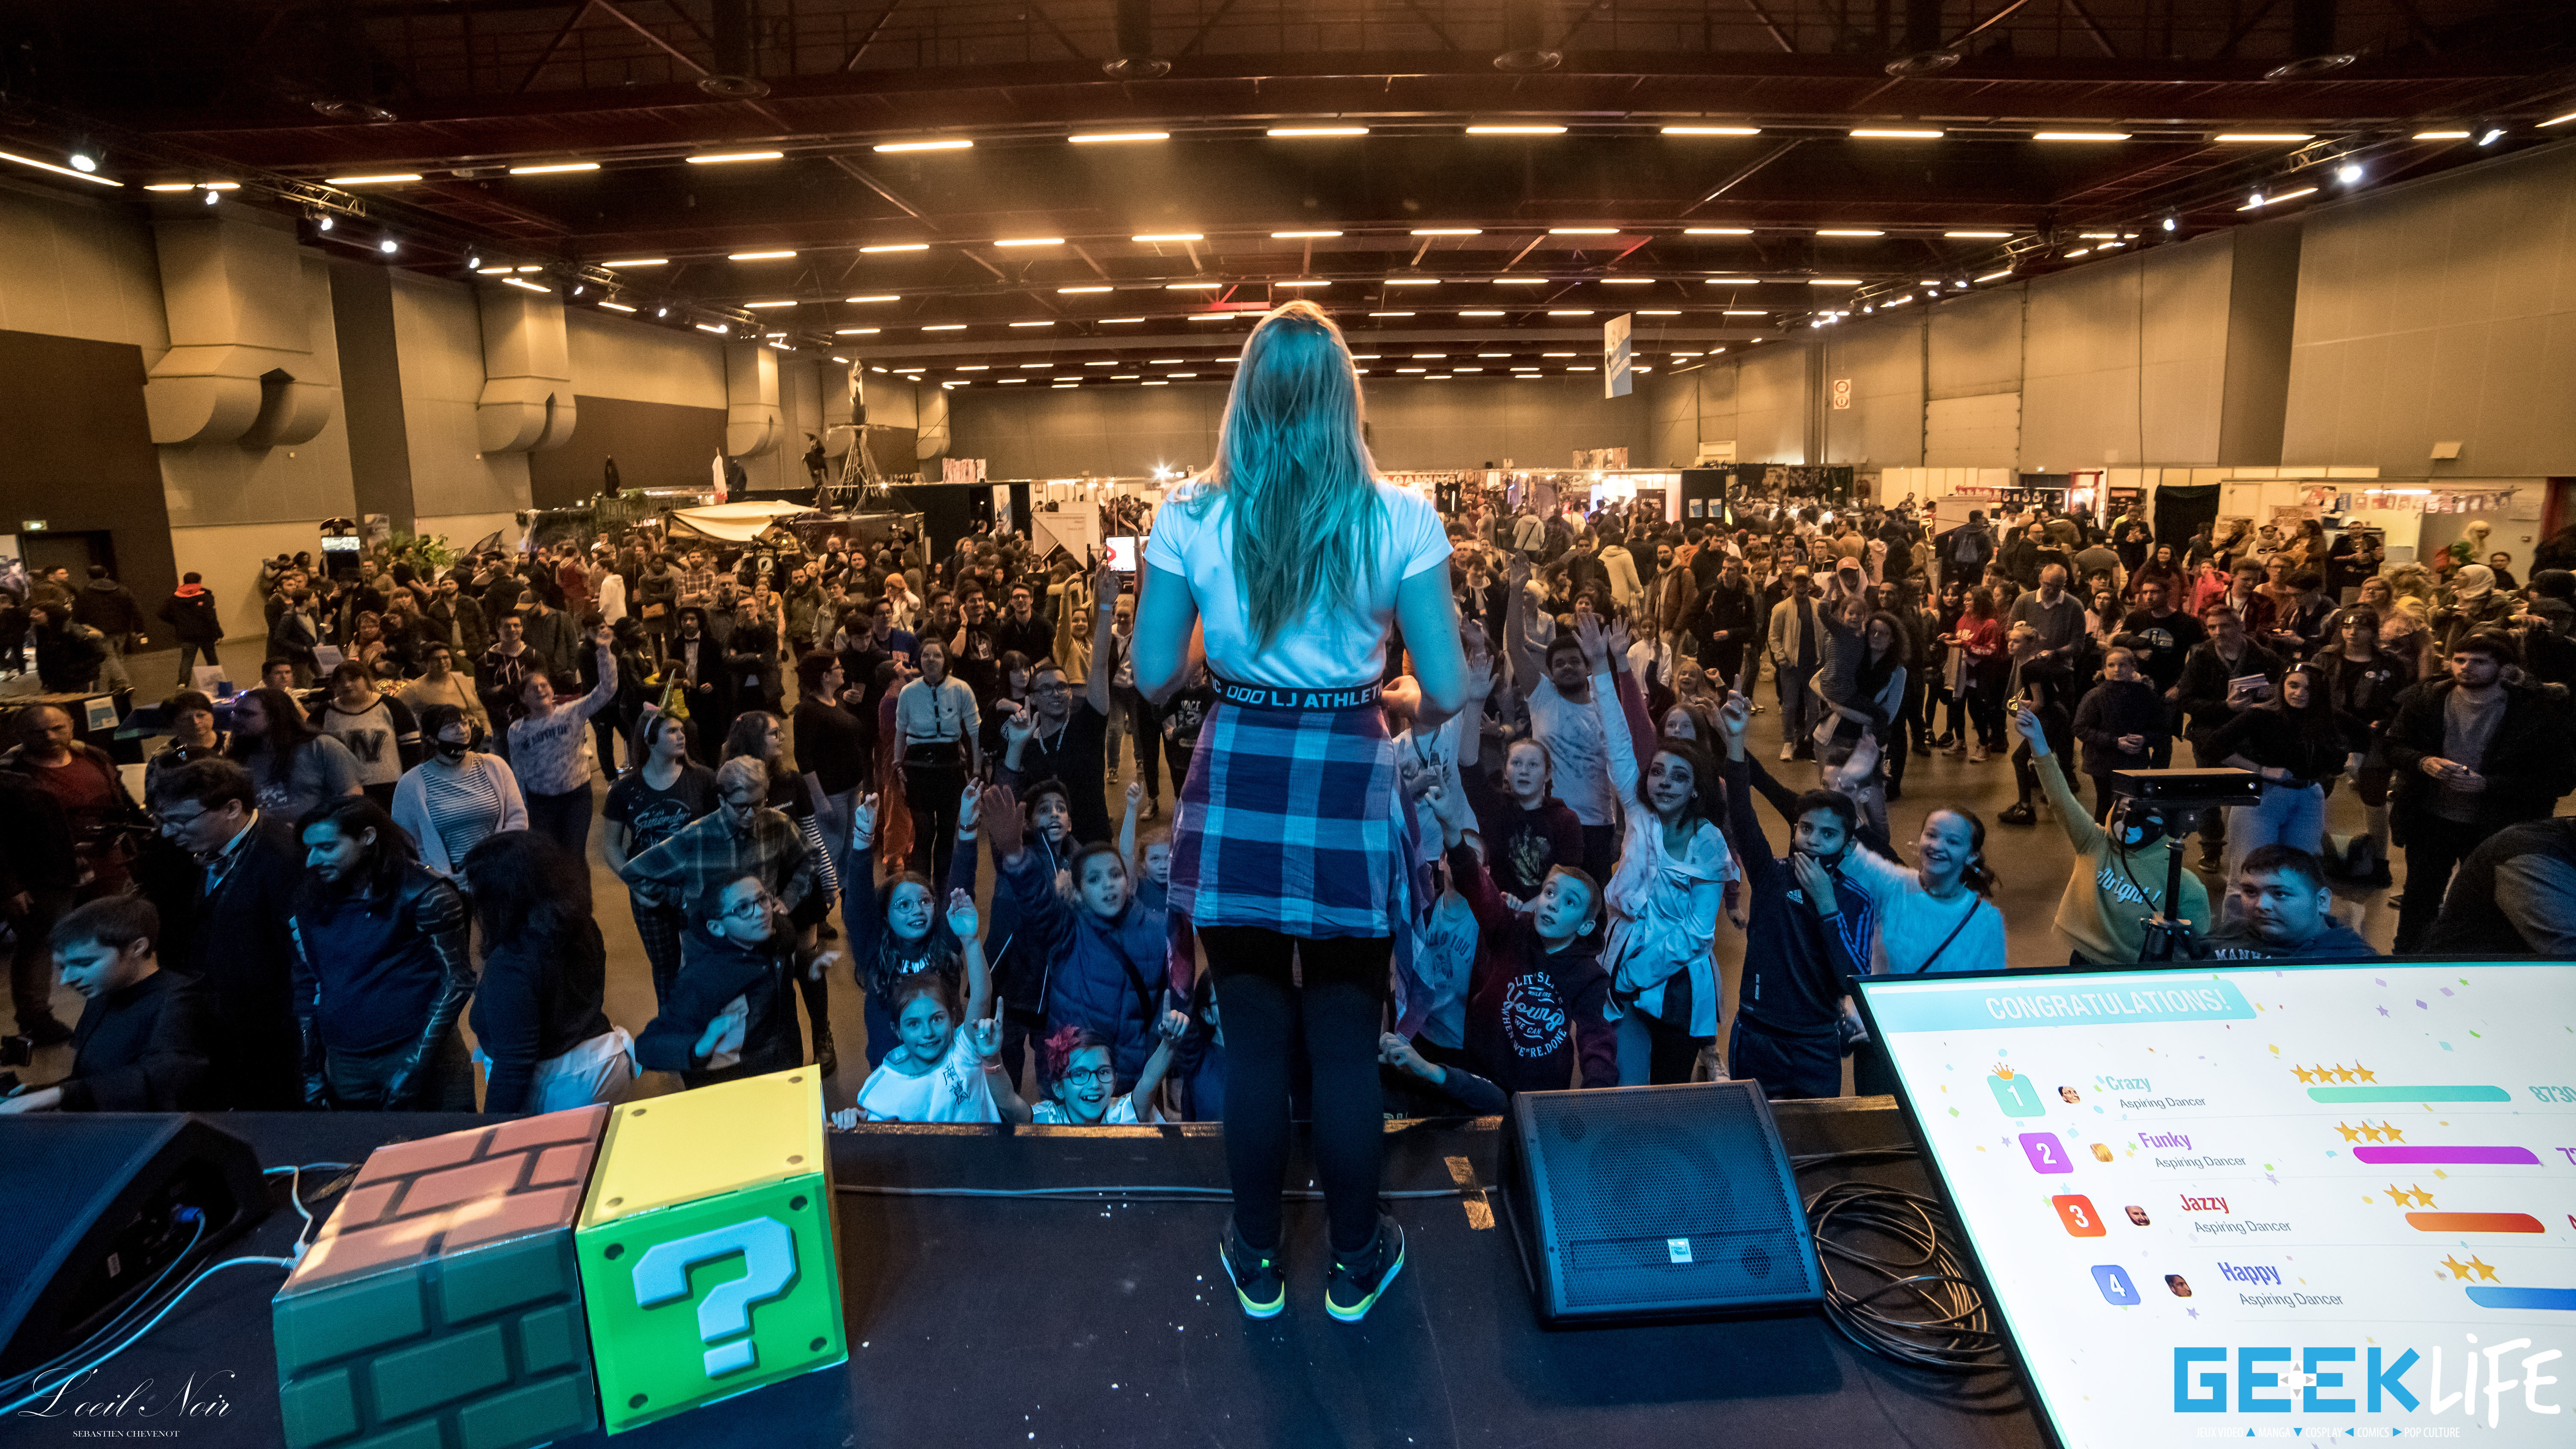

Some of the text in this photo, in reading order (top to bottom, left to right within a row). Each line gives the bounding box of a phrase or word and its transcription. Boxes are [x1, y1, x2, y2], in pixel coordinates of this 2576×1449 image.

[1271, 690, 1297, 707] LJ
[1502, 982, 1565, 1032] Young
[1985, 988, 2232, 1020] CONGRATULATIONS!
[1527, 1027, 1542, 1035] CAN
[2105, 1075, 2152, 1092] Crazy
[2007, 1085, 2024, 1106] 1
[2120, 1097, 2206, 1110] Aspiring Dancer
[2138, 1132, 2192, 1151] Funky
[2036, 1142, 2057, 1164] 2
[2155, 1156, 2247, 1169] Aspiring Dancer
[2555, 1147, 2576, 1166] 7
[2179, 1194, 2230, 1214] Jazzy
[2069, 1205, 2090, 1228] 3
[2194, 1219, 2291, 1234] Aspiring Dancer
[2217, 1262, 2283, 1286] Happy
[2109, 1273, 2126, 1297] 4
[2239, 1292, 2344, 1308] Aspiring Dancer
